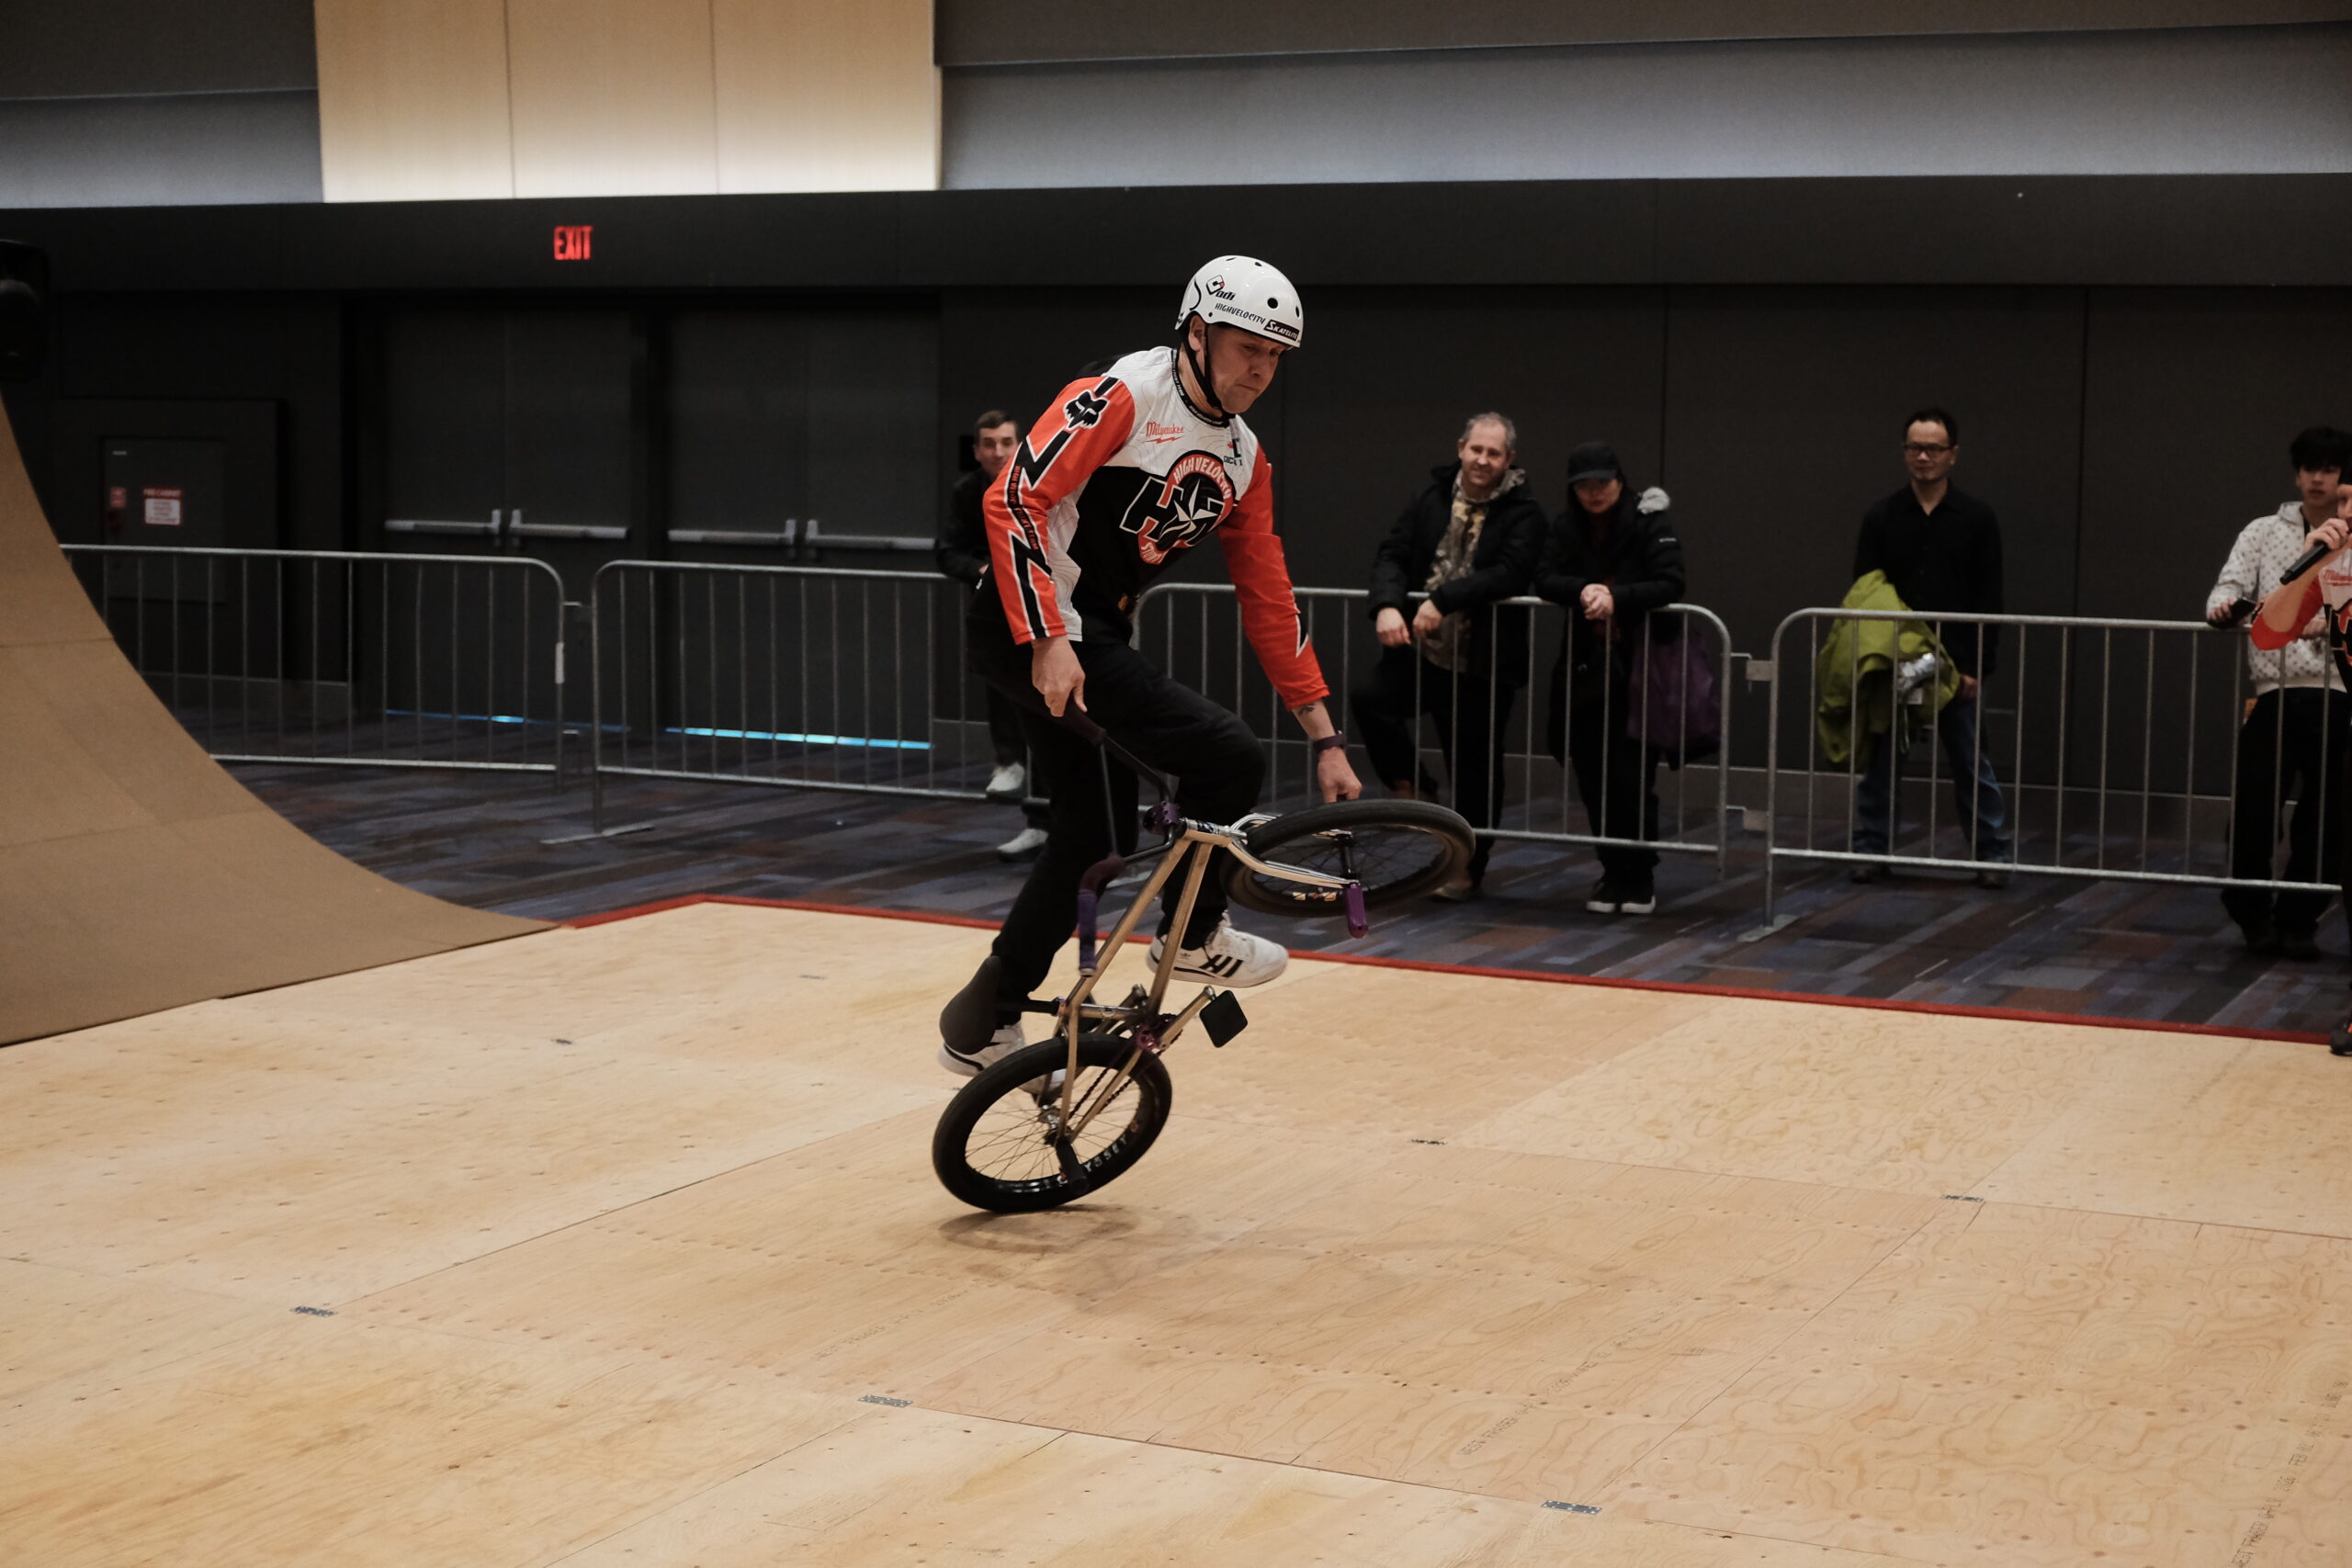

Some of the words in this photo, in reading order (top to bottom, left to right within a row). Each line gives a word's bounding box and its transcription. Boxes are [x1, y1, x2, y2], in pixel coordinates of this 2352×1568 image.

[554, 225, 594, 261] EXIT
[1146, 421, 1184, 437] Milwaukee
[1172, 457, 1194, 484] HIGH
